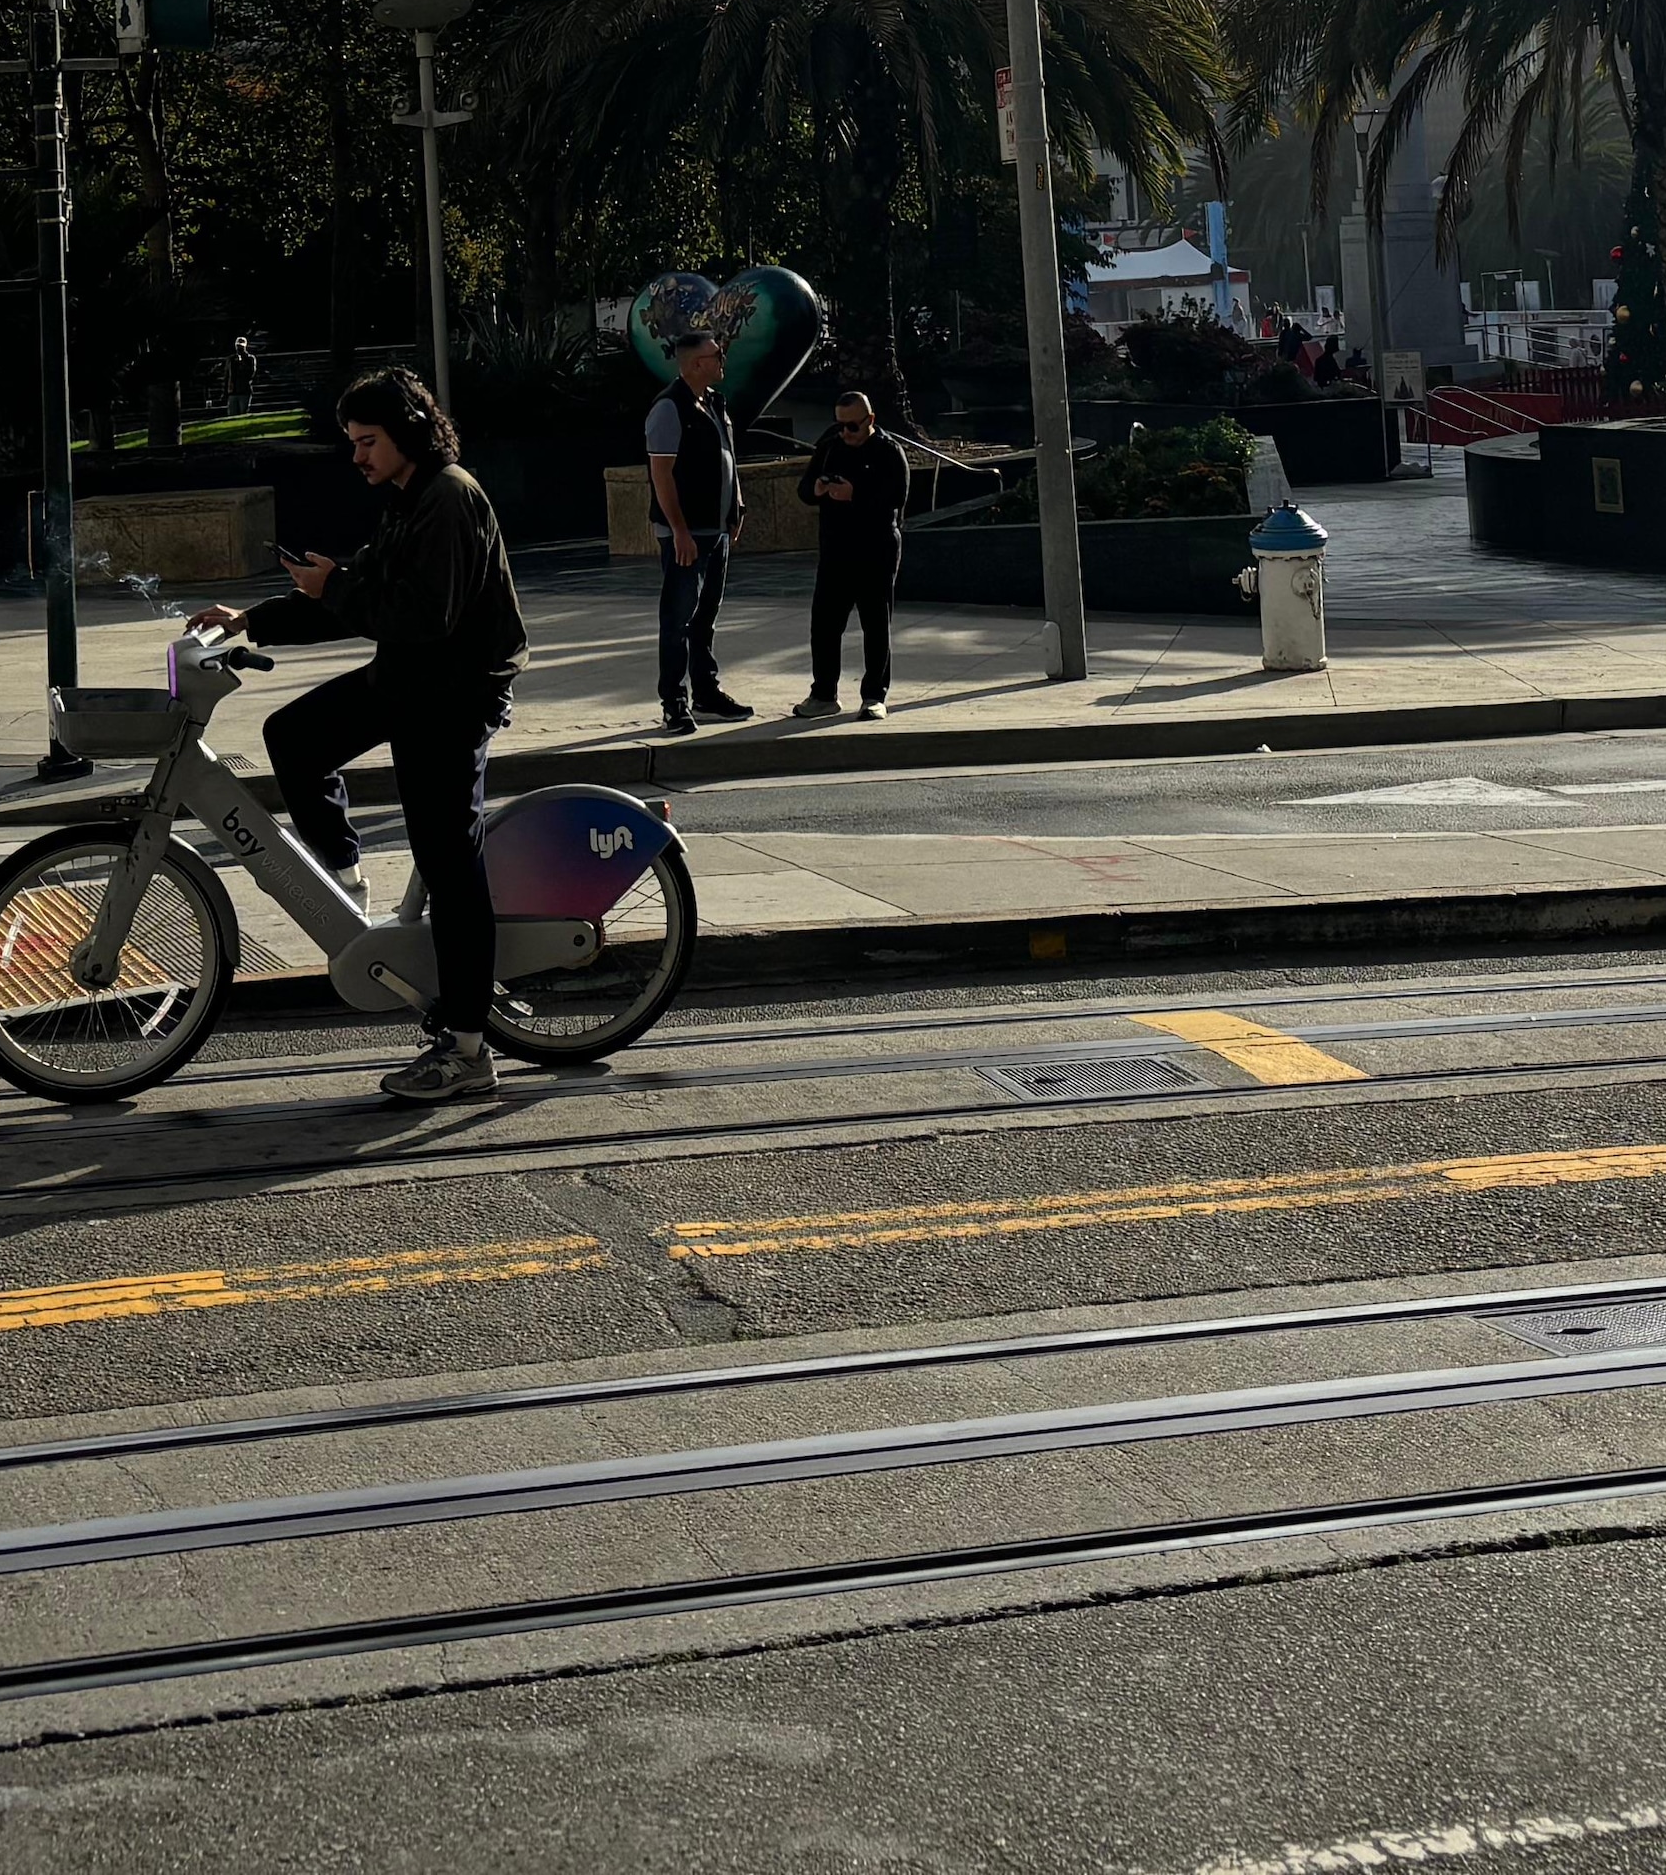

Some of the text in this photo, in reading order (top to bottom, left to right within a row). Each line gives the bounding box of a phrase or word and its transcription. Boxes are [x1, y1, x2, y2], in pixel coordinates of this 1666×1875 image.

[222, 806, 330, 926] bay wheels
[589, 825, 634, 859] lyft
